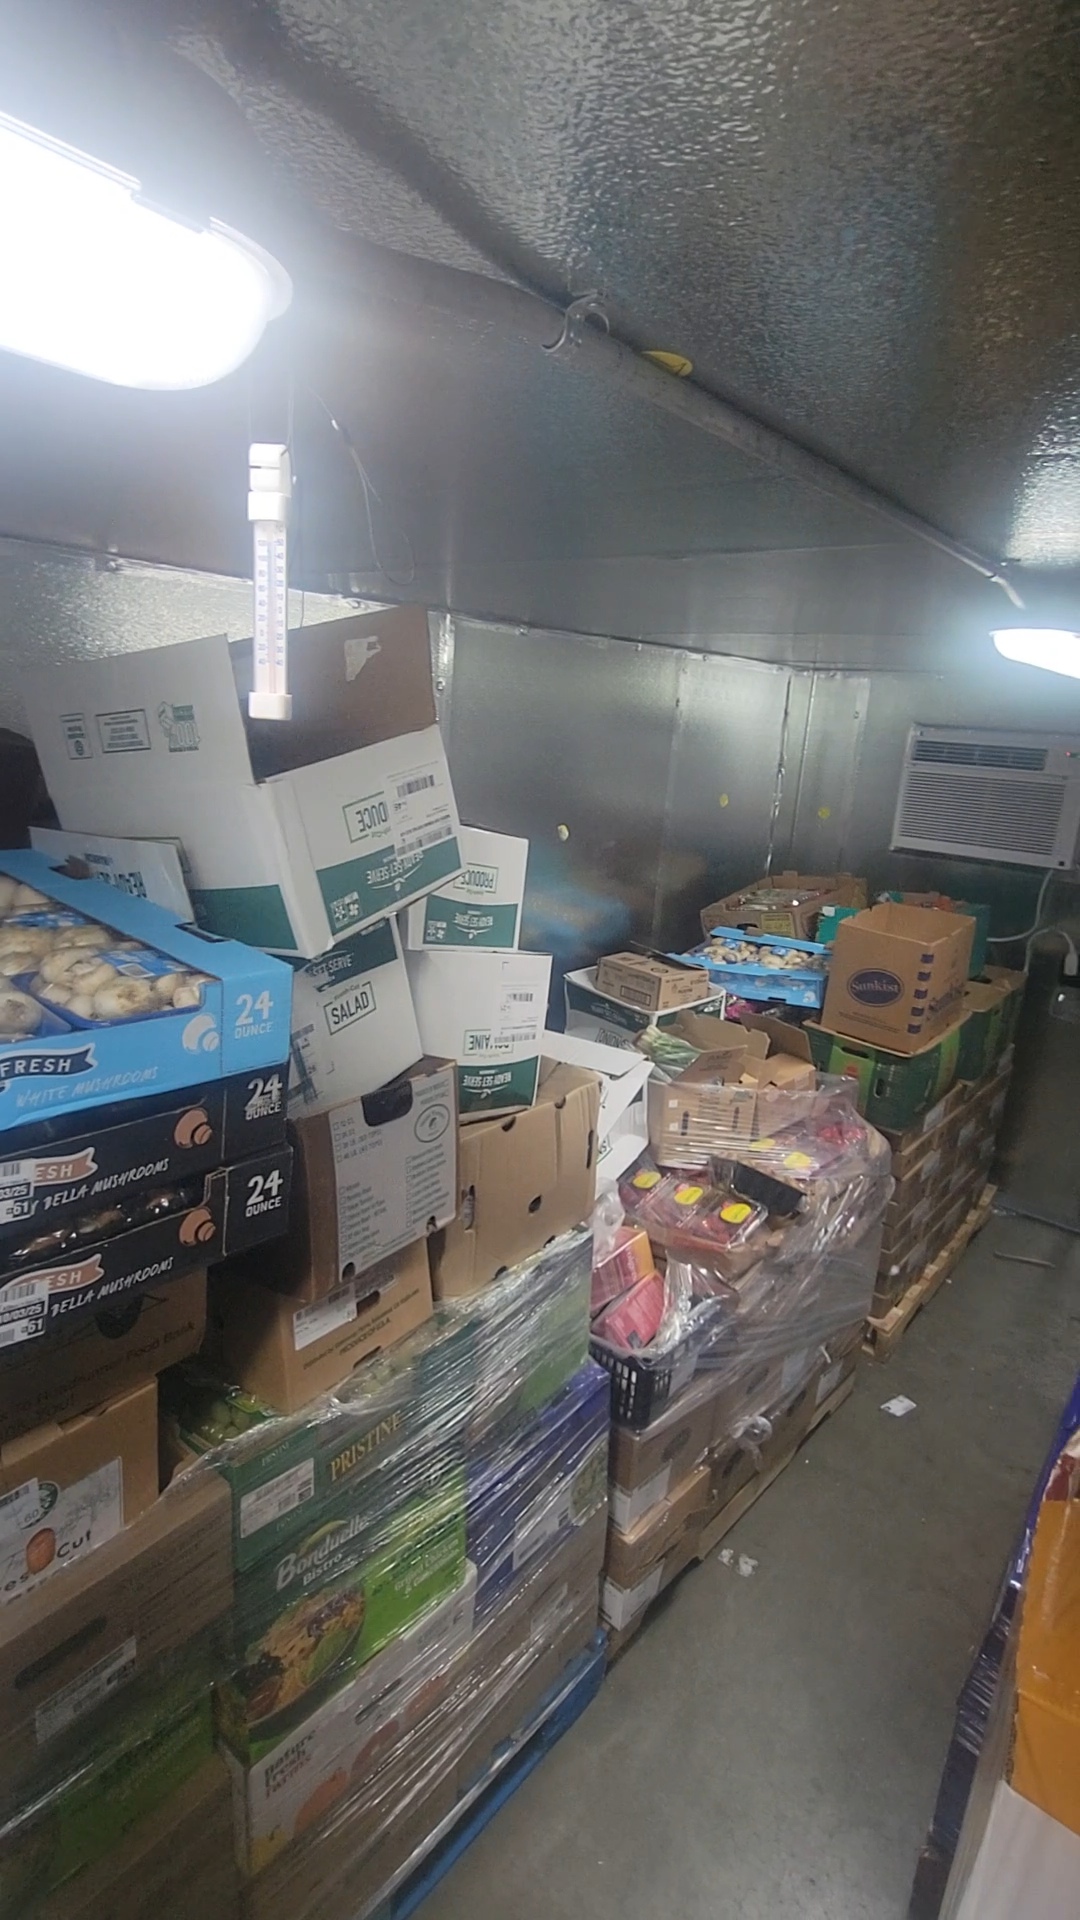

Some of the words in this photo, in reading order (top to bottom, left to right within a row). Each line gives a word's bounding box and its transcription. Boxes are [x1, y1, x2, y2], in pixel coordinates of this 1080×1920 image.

[356, 801, 389, 831] DUCE
[851, 980, 900, 994] Sunkist
[235, 990, 274, 1028] 24
[330, 990, 371, 1026] SALAD
[234, 1021, 274, 1039] OUNCE
[1, 1058, 72, 1078] FRESH
[16, 1085, 69, 1108] WHITE
[72, 1066, 159, 1097] MUSHROOMS
[246, 1073, 283, 1107] 24
[245, 1101, 283, 1121] OUNCE
[35, 1163, 73, 1181] ESH
[43, 1184, 90, 1211] BELLA
[91, 1157, 170, 1194] MUSHROOMS
[246, 1169, 284, 1207] 24
[245, 1196, 283, 1218] OUNCE
[51, 1290, 95, 1318] BELLA
[97, 1256, 175, 1300] MUSHROOMS
[330, 1412, 401, 1482] PRISTINE
[275, 1513, 369, 1591] Bonduelle
[302, 1551, 344, 1587] Bistro
